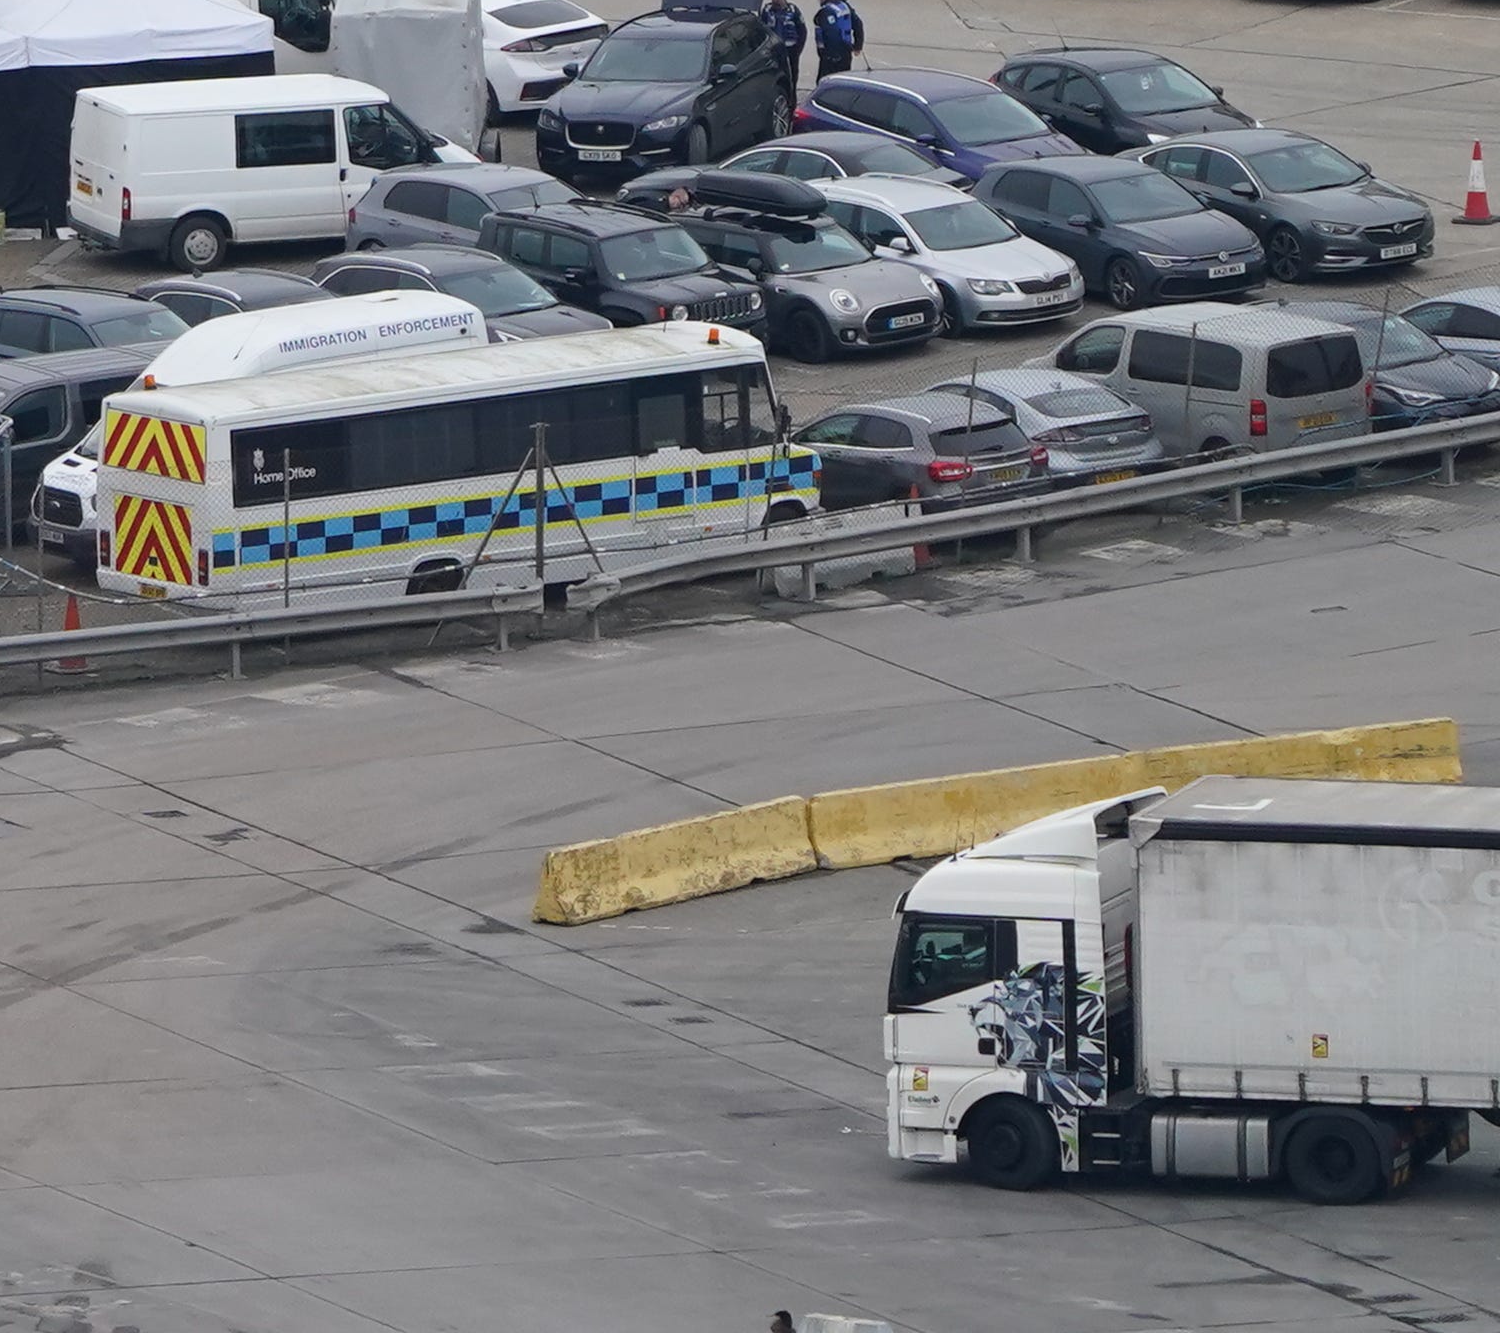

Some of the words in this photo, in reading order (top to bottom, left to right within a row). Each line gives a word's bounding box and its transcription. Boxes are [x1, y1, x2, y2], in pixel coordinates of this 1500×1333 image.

[279, 329, 367, 353] IMMIGRATION
[379, 312, 476, 337] ENFORCEMENT
[254, 471, 284, 484] Home
[287, 466, 317, 481] Office
